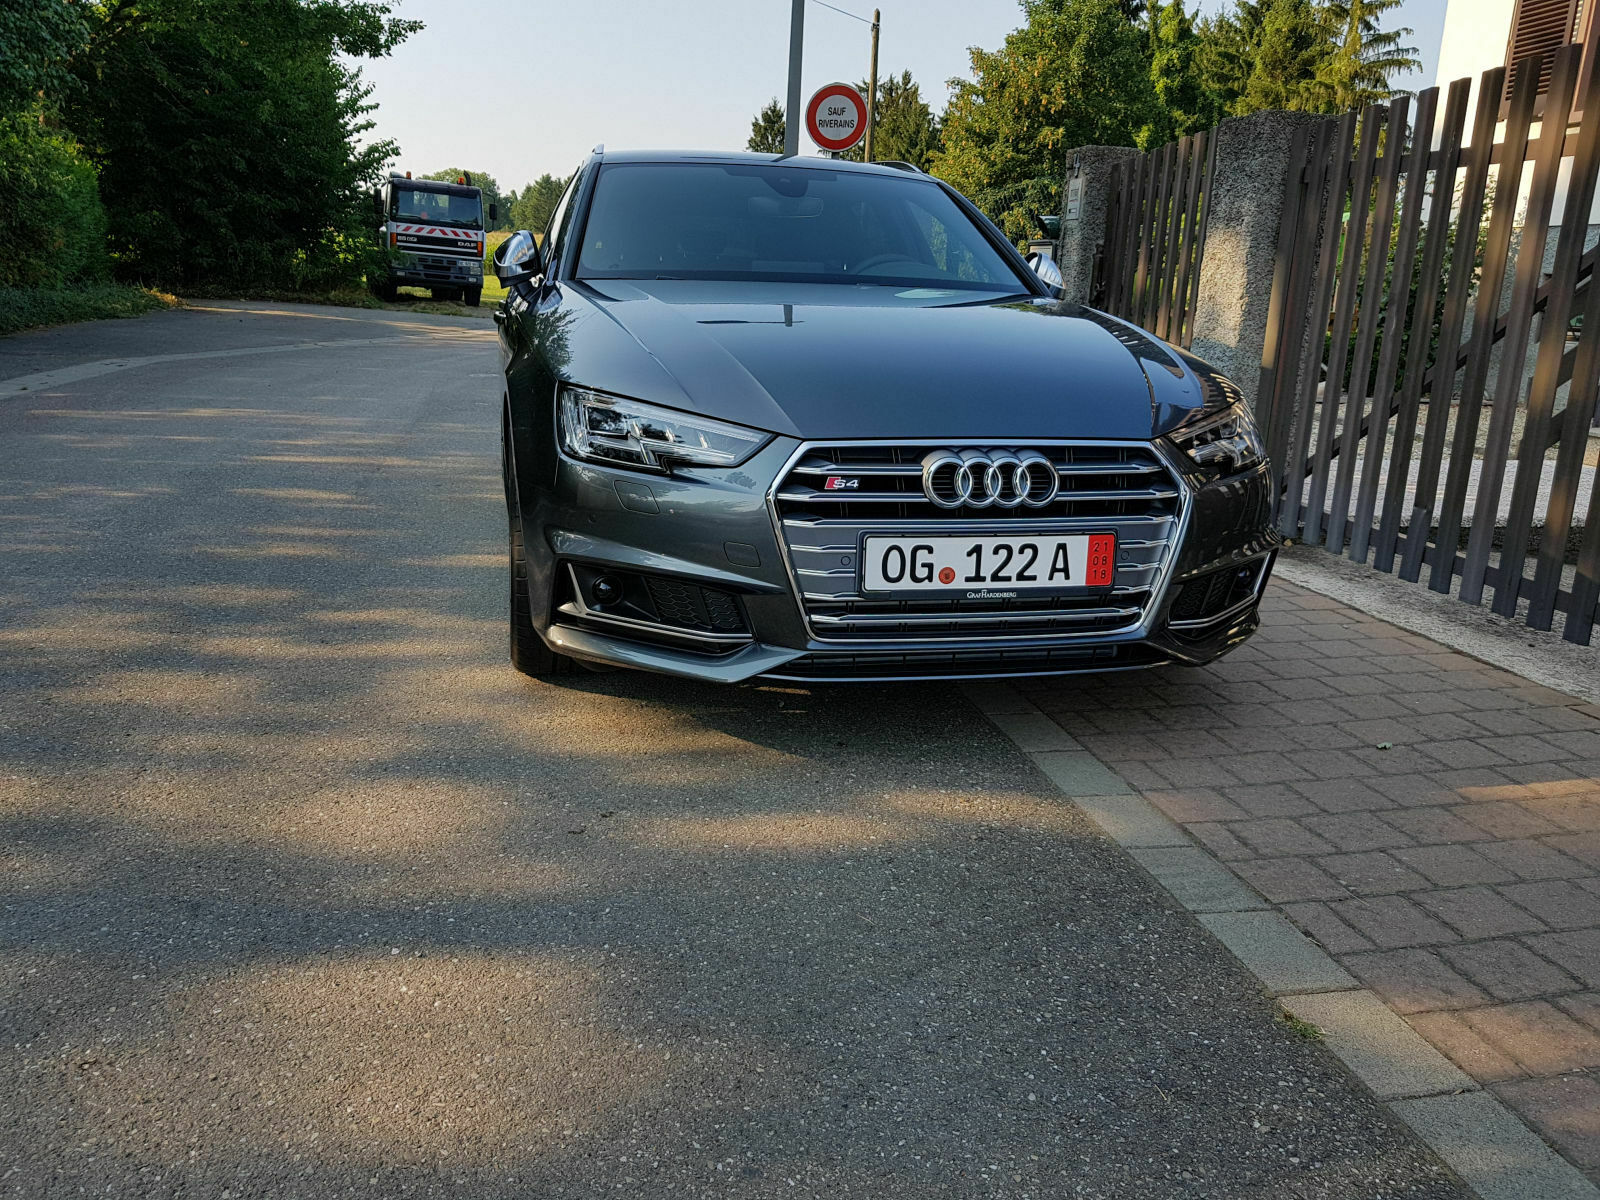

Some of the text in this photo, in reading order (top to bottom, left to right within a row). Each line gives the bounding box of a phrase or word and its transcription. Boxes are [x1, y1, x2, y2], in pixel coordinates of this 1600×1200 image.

[827, 106, 847, 116] SAUF
[818, 119, 855, 129] RIVERAINS
[832, 479, 859, 489] S4
[1094, 541, 1108, 552] 21
[881, 542, 1071, 583] OG 122 A
[1092, 555, 1108, 566] 08
[1093, 569, 1107, 579] 18
